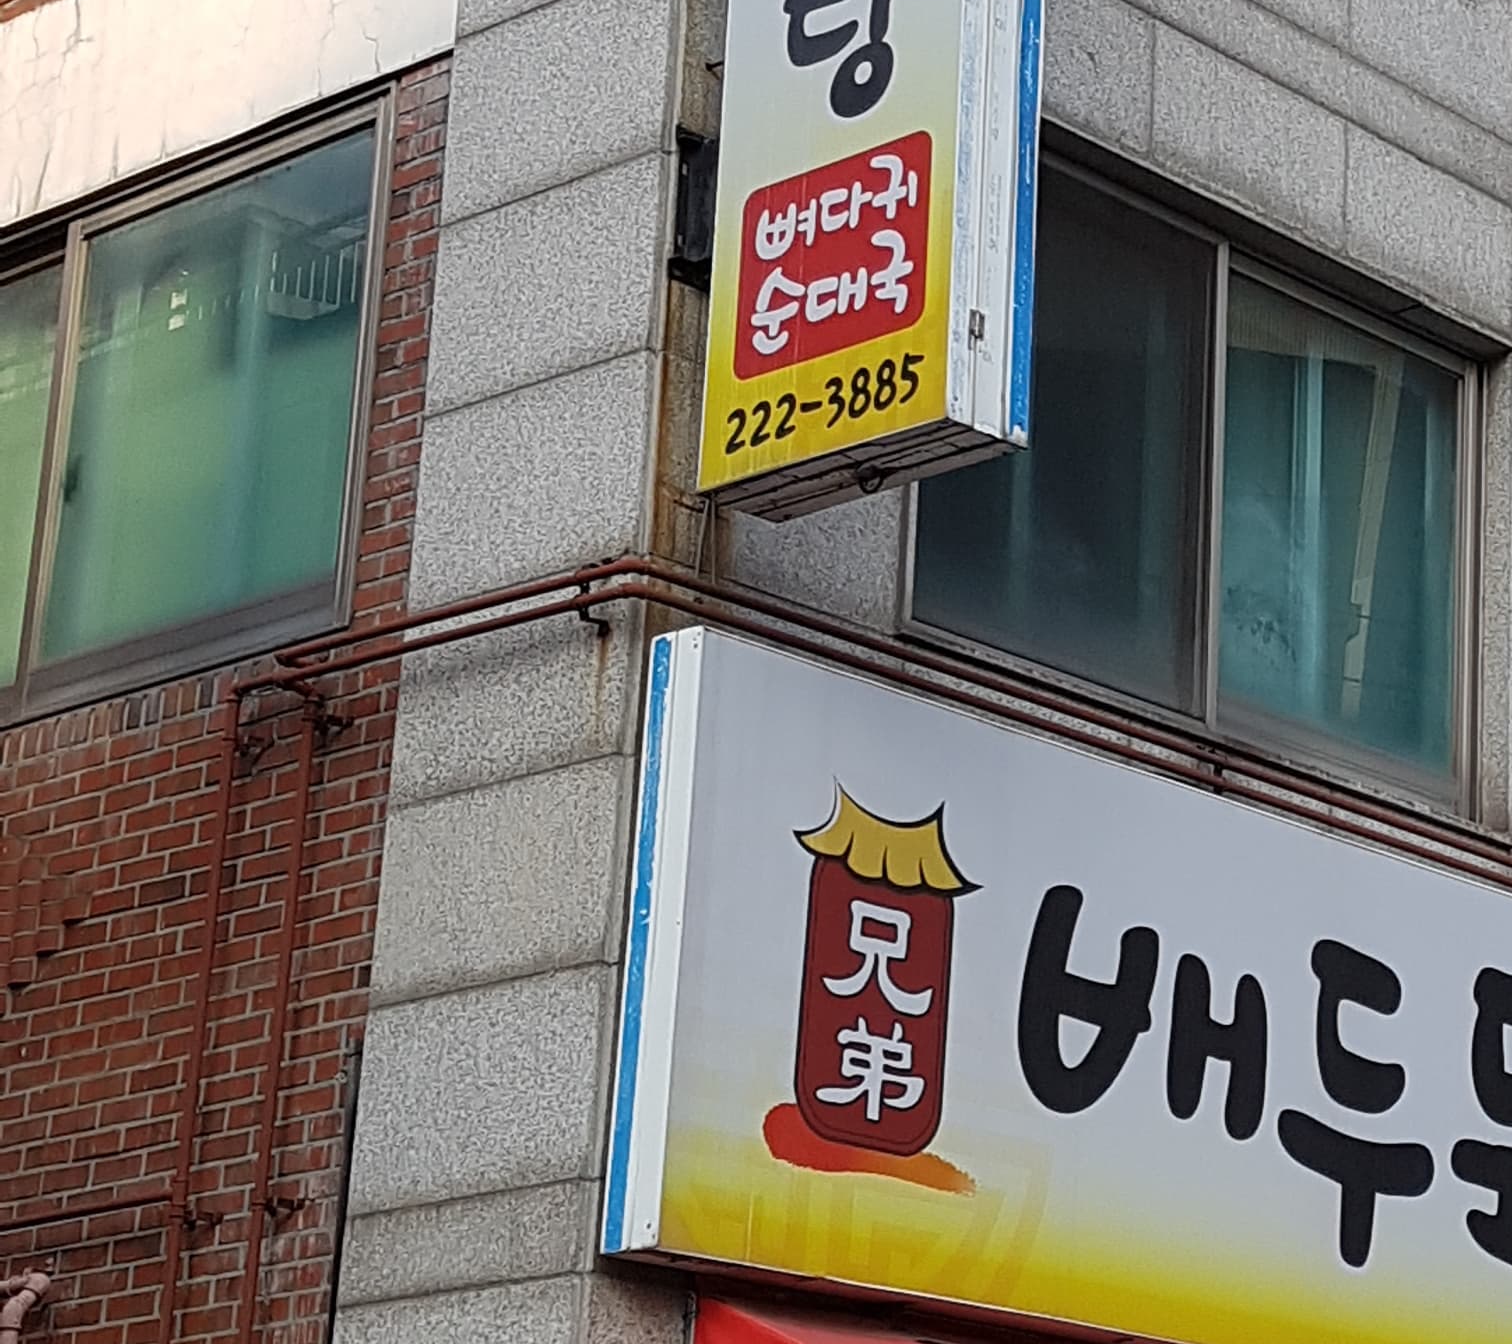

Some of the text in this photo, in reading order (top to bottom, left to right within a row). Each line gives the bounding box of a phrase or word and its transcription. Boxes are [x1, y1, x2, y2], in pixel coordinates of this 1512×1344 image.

[753, 154, 918, 264] 뼈다귀
[749, 228, 915, 356] 순대국
[726, 351, 925, 456] 222-3885
[816, 898, 935, 1123] 兄弟
